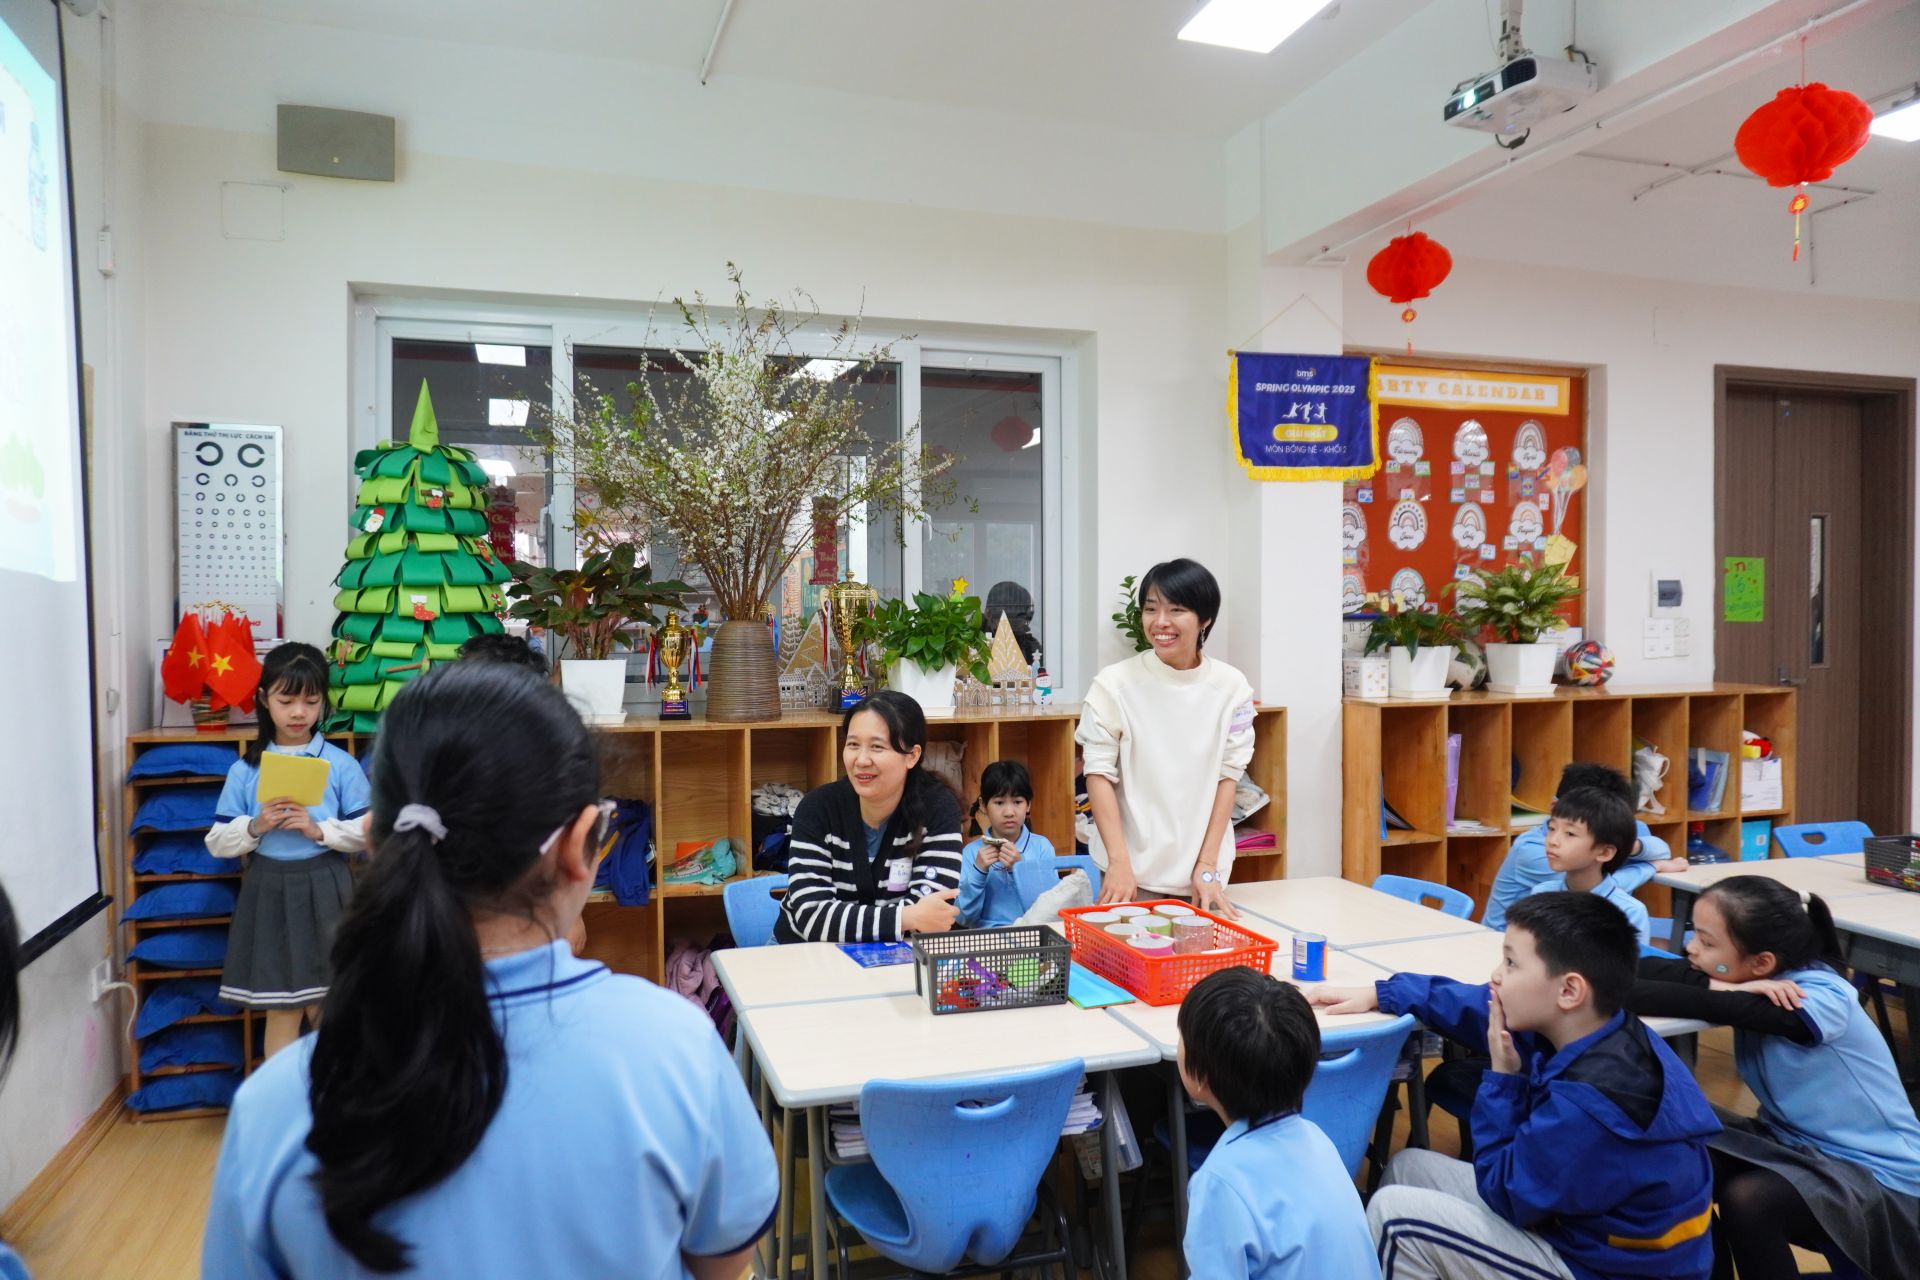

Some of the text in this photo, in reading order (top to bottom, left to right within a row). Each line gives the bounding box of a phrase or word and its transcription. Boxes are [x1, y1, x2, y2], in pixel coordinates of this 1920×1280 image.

[1255, 382, 1356, 394] SPRING OLYMPIC 2025
[1438, 382, 1546, 401] CALENDAR
[1285, 443, 1306, 454] BÓNG
